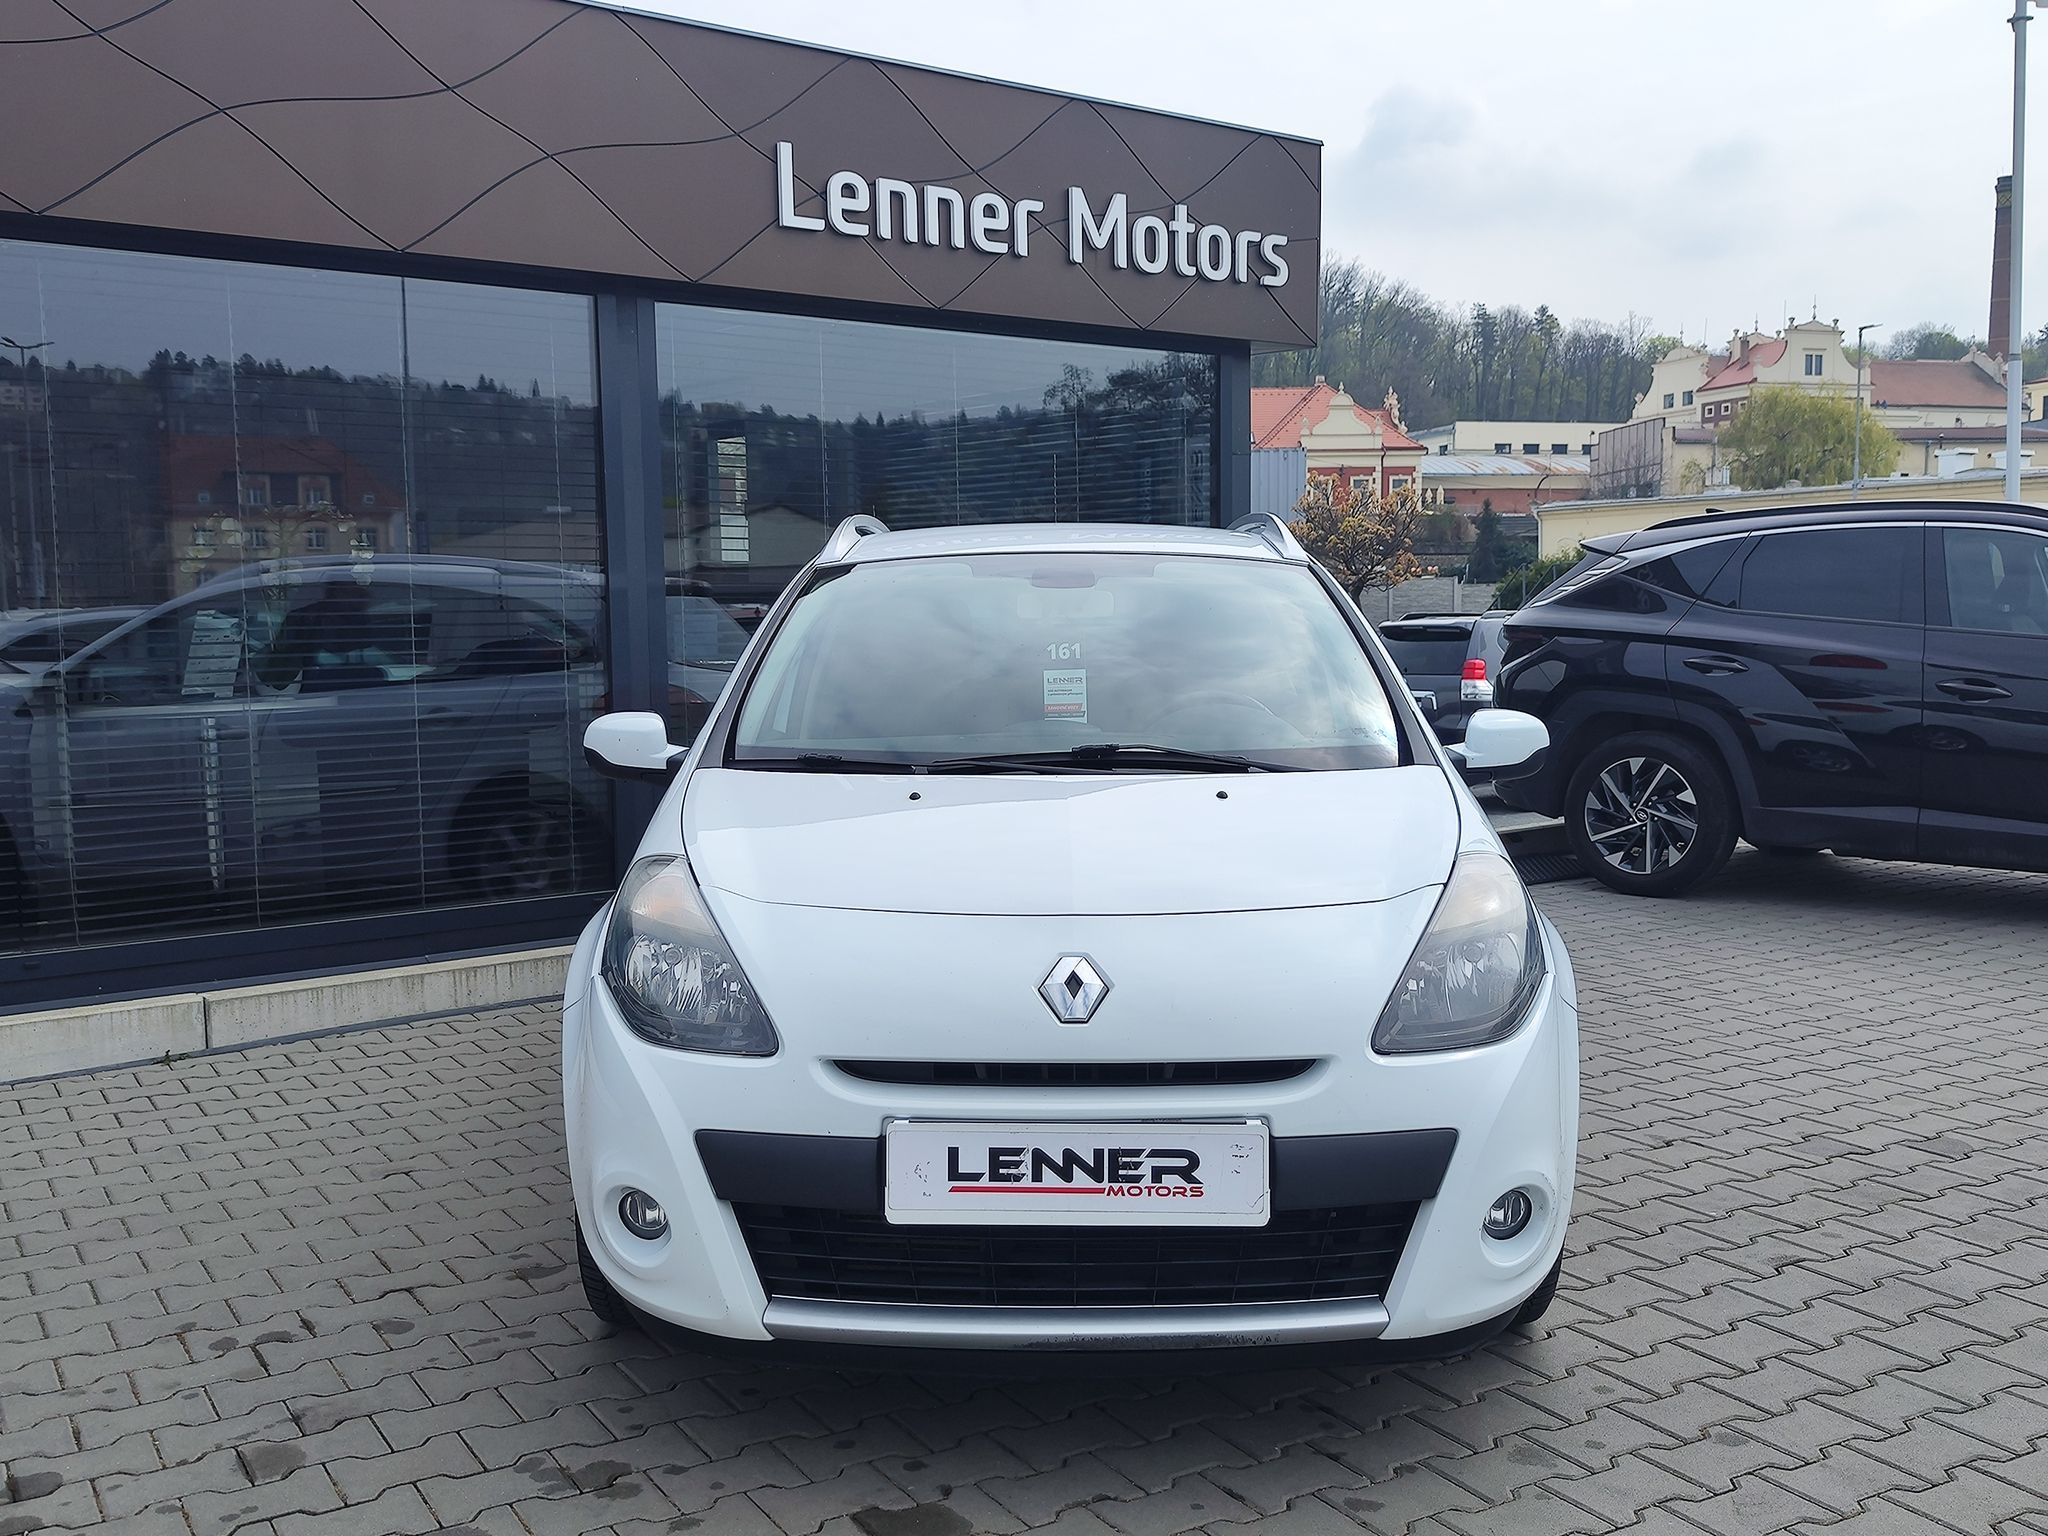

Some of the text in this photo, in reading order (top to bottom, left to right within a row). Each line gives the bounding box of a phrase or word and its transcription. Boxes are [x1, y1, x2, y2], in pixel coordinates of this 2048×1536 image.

[776, 141, 1289, 287] Lenner Motors
[1046, 642, 1081, 660] 161
[1047, 676, 1083, 685] LENNER
[947, 1146, 1205, 1184] LENNER
[1106, 1185, 1205, 1198] MOTORS
